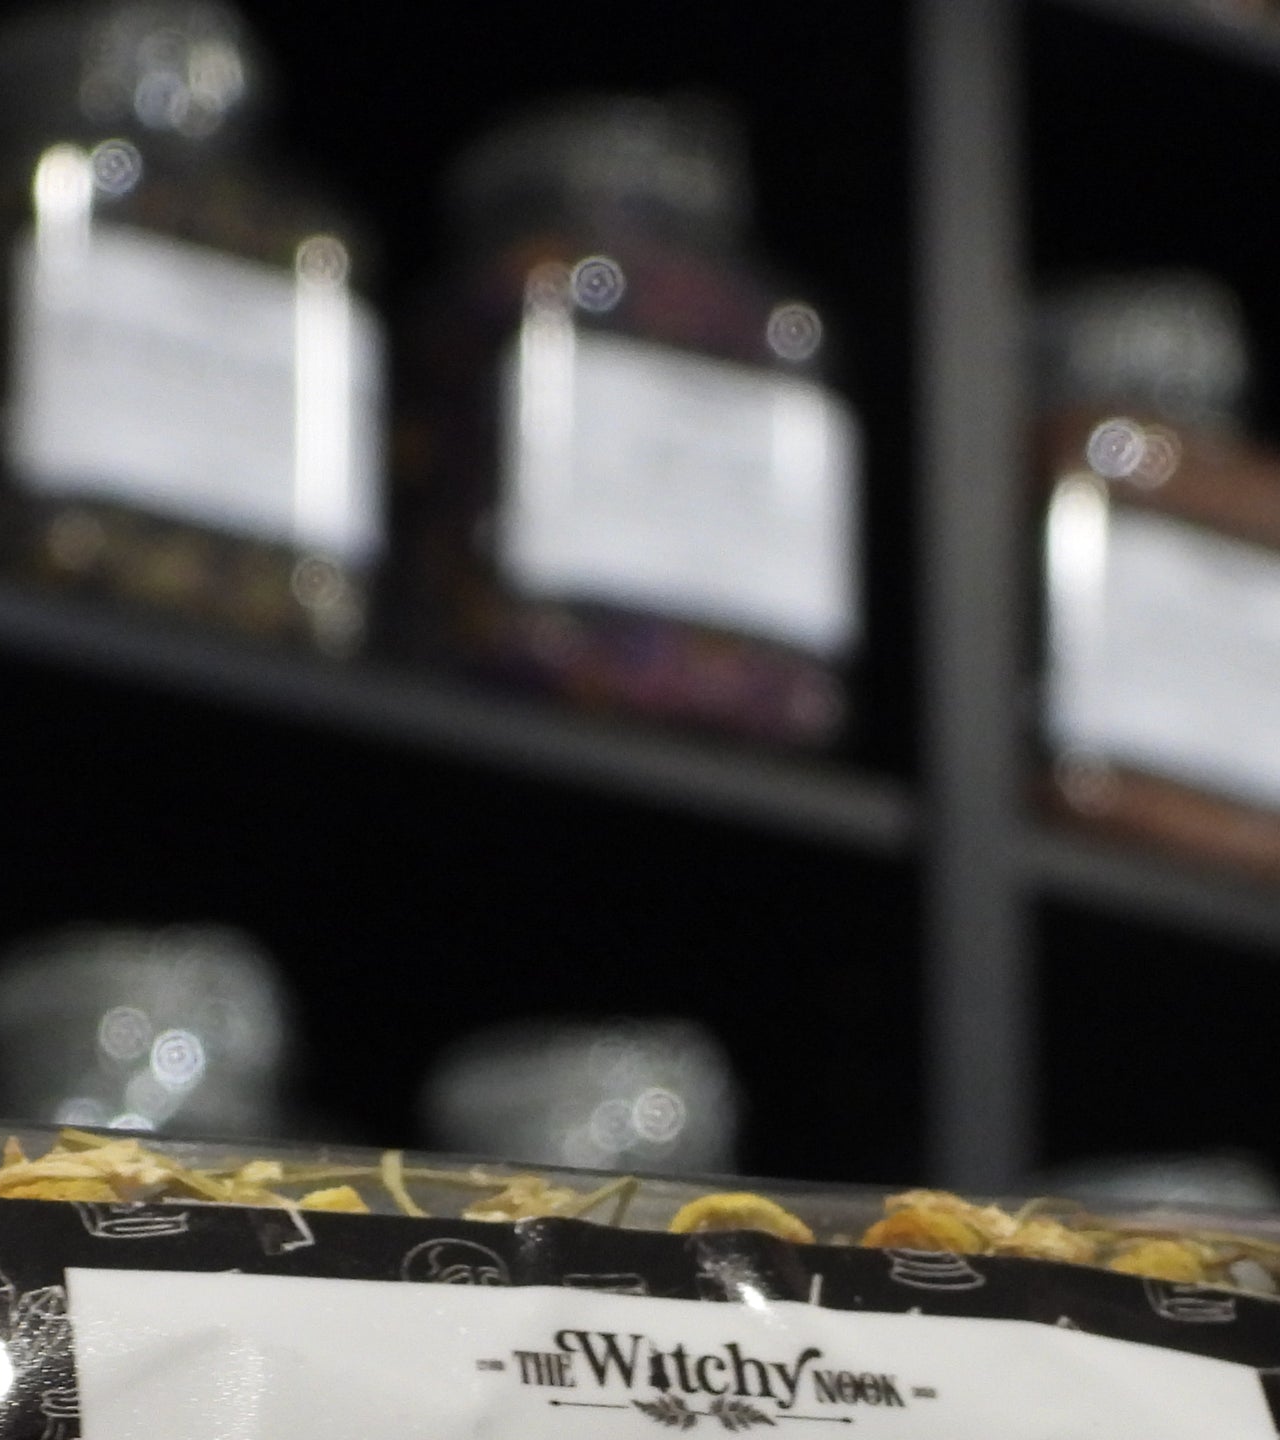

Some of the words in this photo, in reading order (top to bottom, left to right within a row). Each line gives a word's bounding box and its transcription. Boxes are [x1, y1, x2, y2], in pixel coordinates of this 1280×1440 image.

[513, 1350, 578, 1388] THE
[554, 1329, 823, 1410] Witchy
[812, 1369, 907, 1408] NOOK
